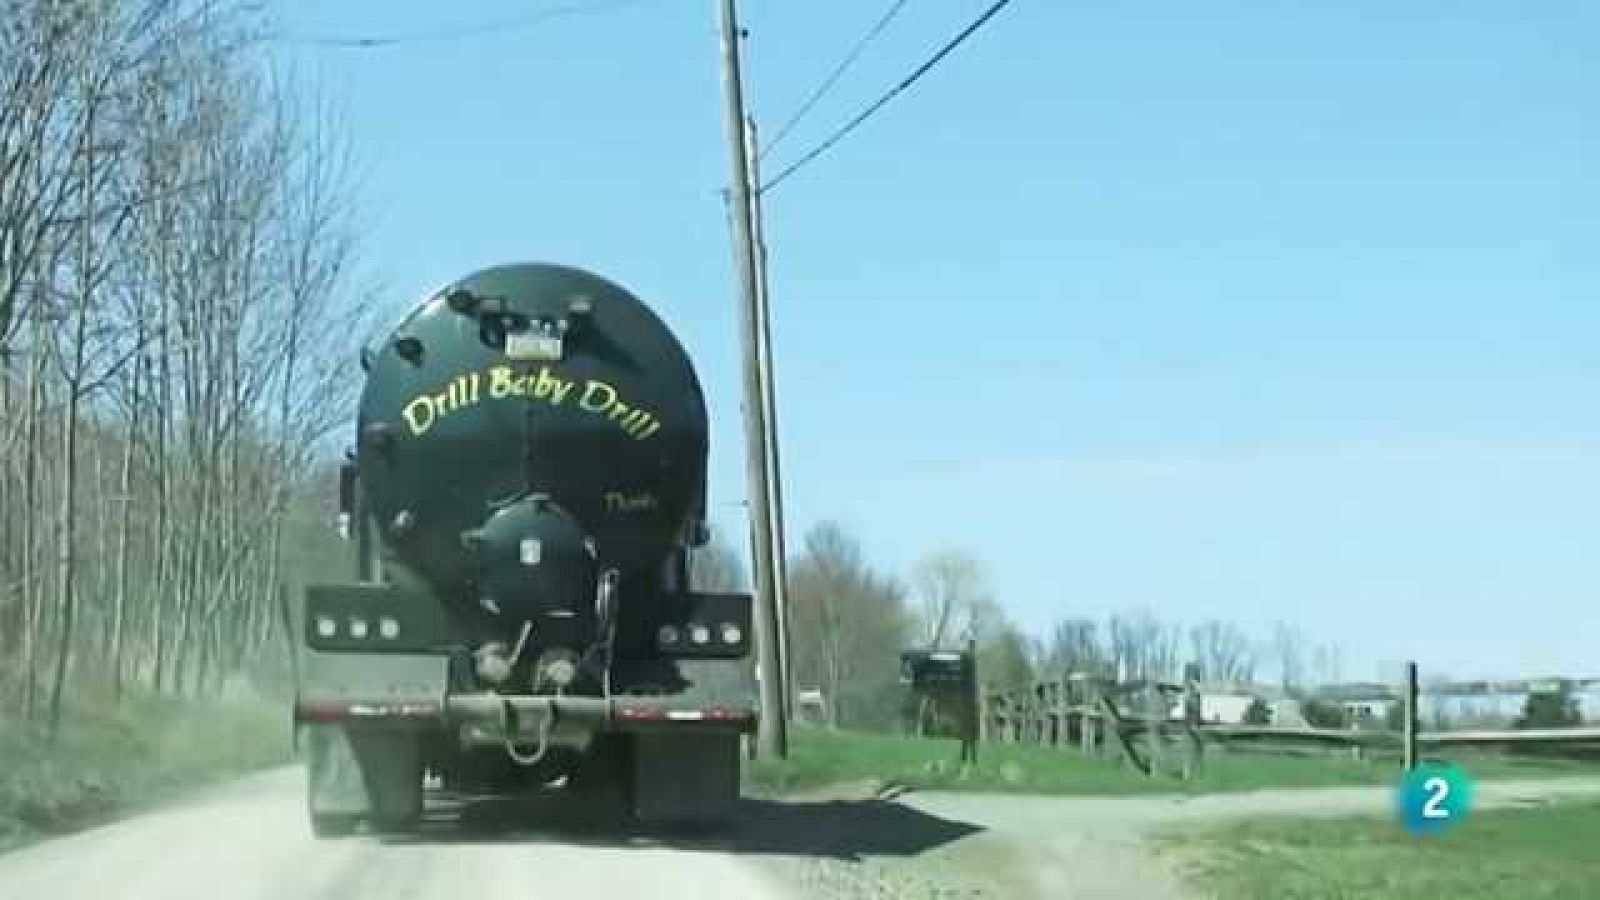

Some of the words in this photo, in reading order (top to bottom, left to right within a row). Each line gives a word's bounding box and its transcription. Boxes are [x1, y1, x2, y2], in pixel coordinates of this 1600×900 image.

[402, 372, 479, 436] Drill
[489, 365, 575, 405] Baby
[579, 379, 661, 440] Drill
